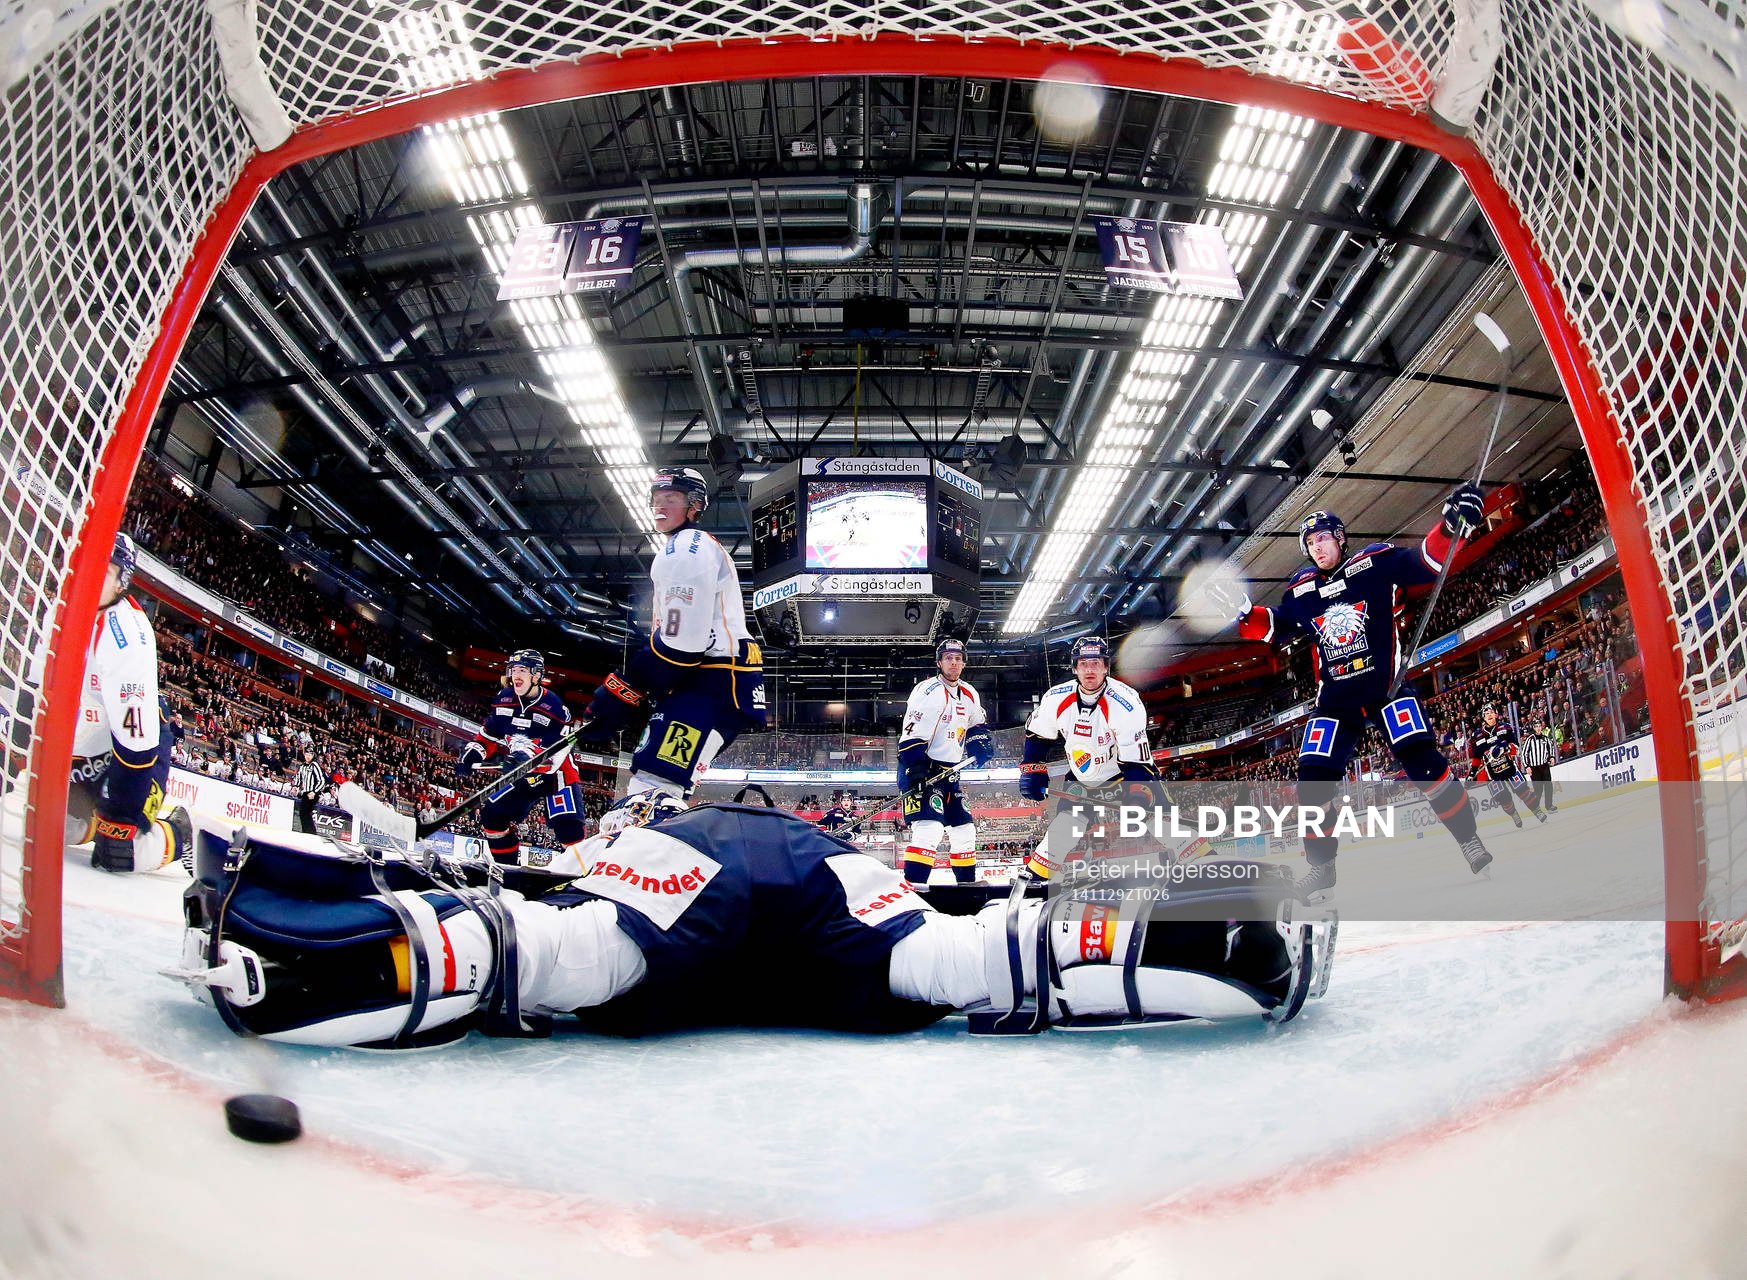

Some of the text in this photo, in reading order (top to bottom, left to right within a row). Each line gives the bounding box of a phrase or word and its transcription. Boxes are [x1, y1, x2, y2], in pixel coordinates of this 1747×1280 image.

[586, 236, 623, 265] 16
[1114, 235, 1150, 264] 15
[1182, 241, 1218, 271] 10
[576, 279, 616, 291] HELBER
[1113, 276, 1170, 292] JACOBSSON
[833, 460, 921, 474] Stångåstaden
[936, 462, 981, 498] Corren
[1346, 560, 1371, 577] LEGENDS
[1579, 556, 1595, 571] SAAB
[755, 581, 799, 607] Corren
[831, 576, 922, 592] Stångåstaden
[665, 608, 681, 638] 8
[85, 709, 100, 723] 91
[122, 706, 144, 738] 41
[947, 731, 956, 739] 18
[1094, 756, 1105, 765] 91
[1138, 741, 1150, 762] 10
[1595, 744, 1640, 771] ActiPro
[1601, 765, 1637, 790] Event
[244, 789, 271, 809] TEAM
[226, 801, 269, 825] SPORTIA
[593, 859, 707, 896] zehnder
